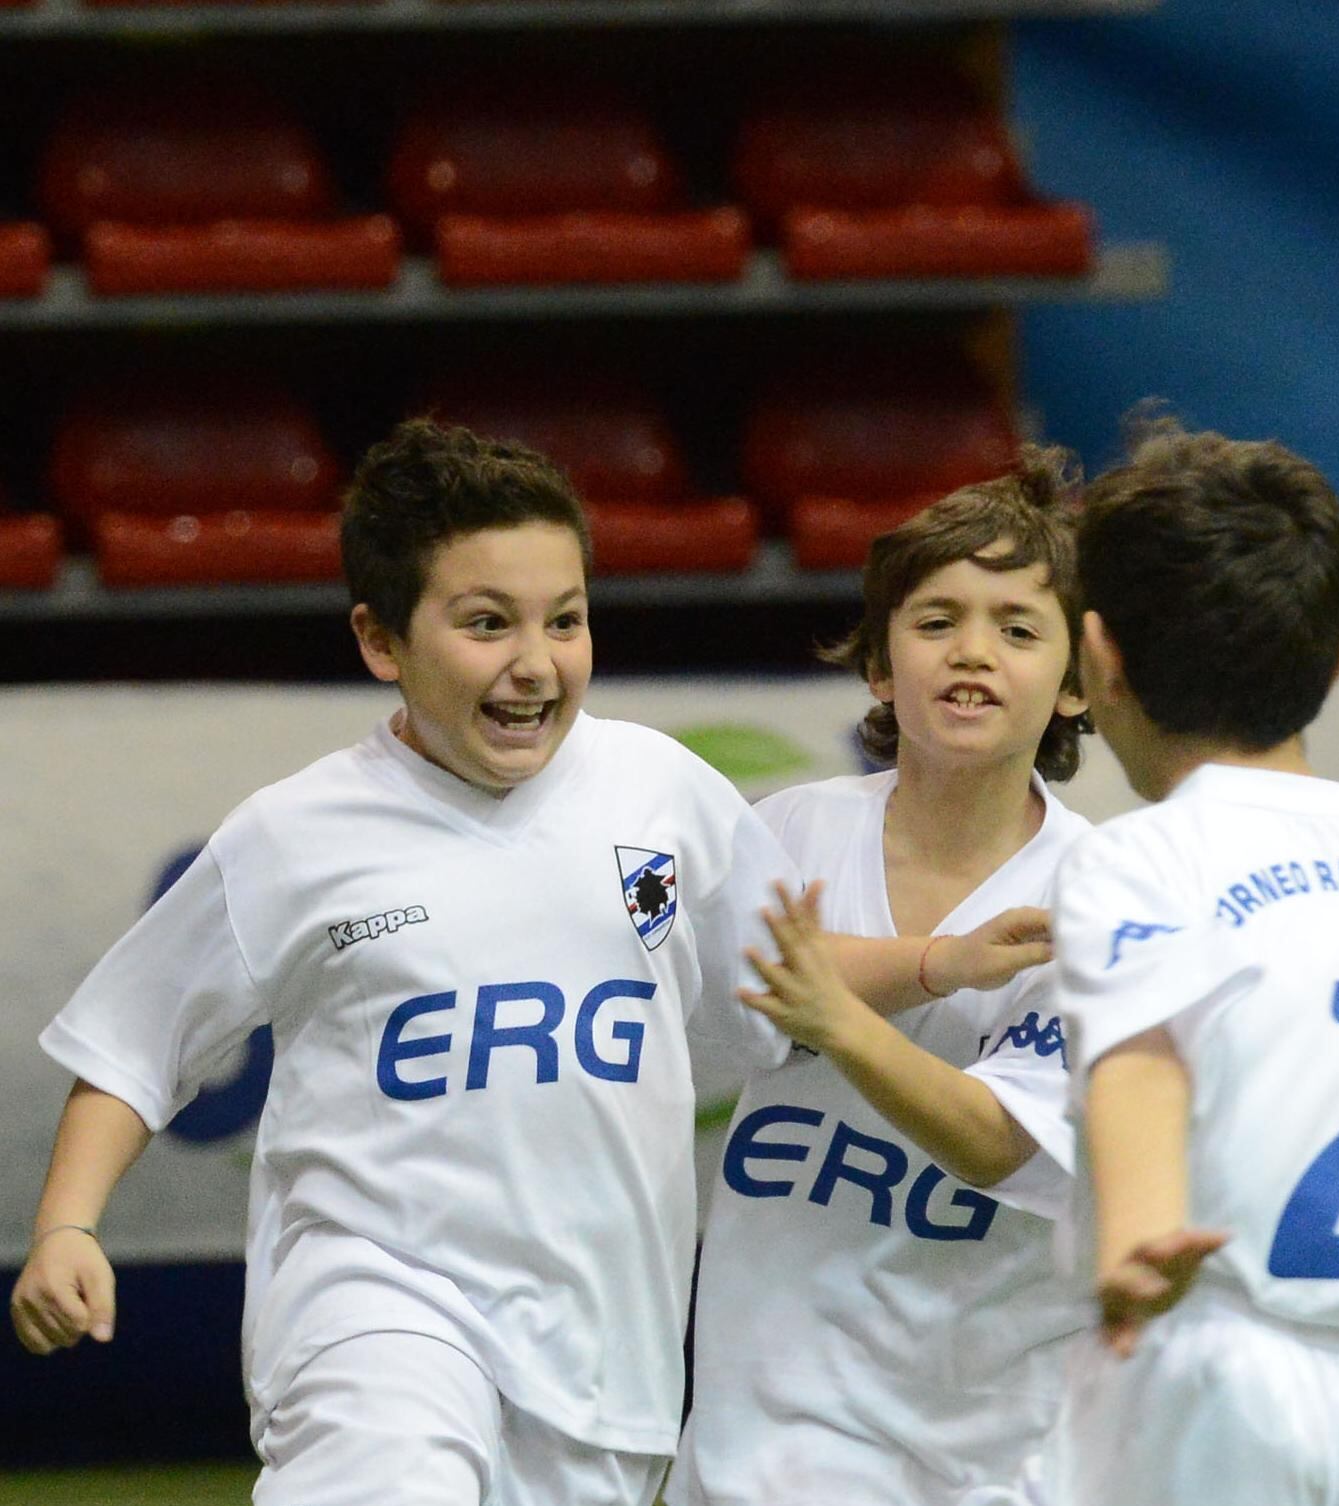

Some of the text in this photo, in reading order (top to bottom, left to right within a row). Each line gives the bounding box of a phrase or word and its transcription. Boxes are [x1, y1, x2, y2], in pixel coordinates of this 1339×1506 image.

[328, 905, 429, 950] Kappa
[1215, 861, 1310, 927] ORNEO
[376, 979, 657, 1101] ERG
[723, 1105, 999, 1242] ERG
